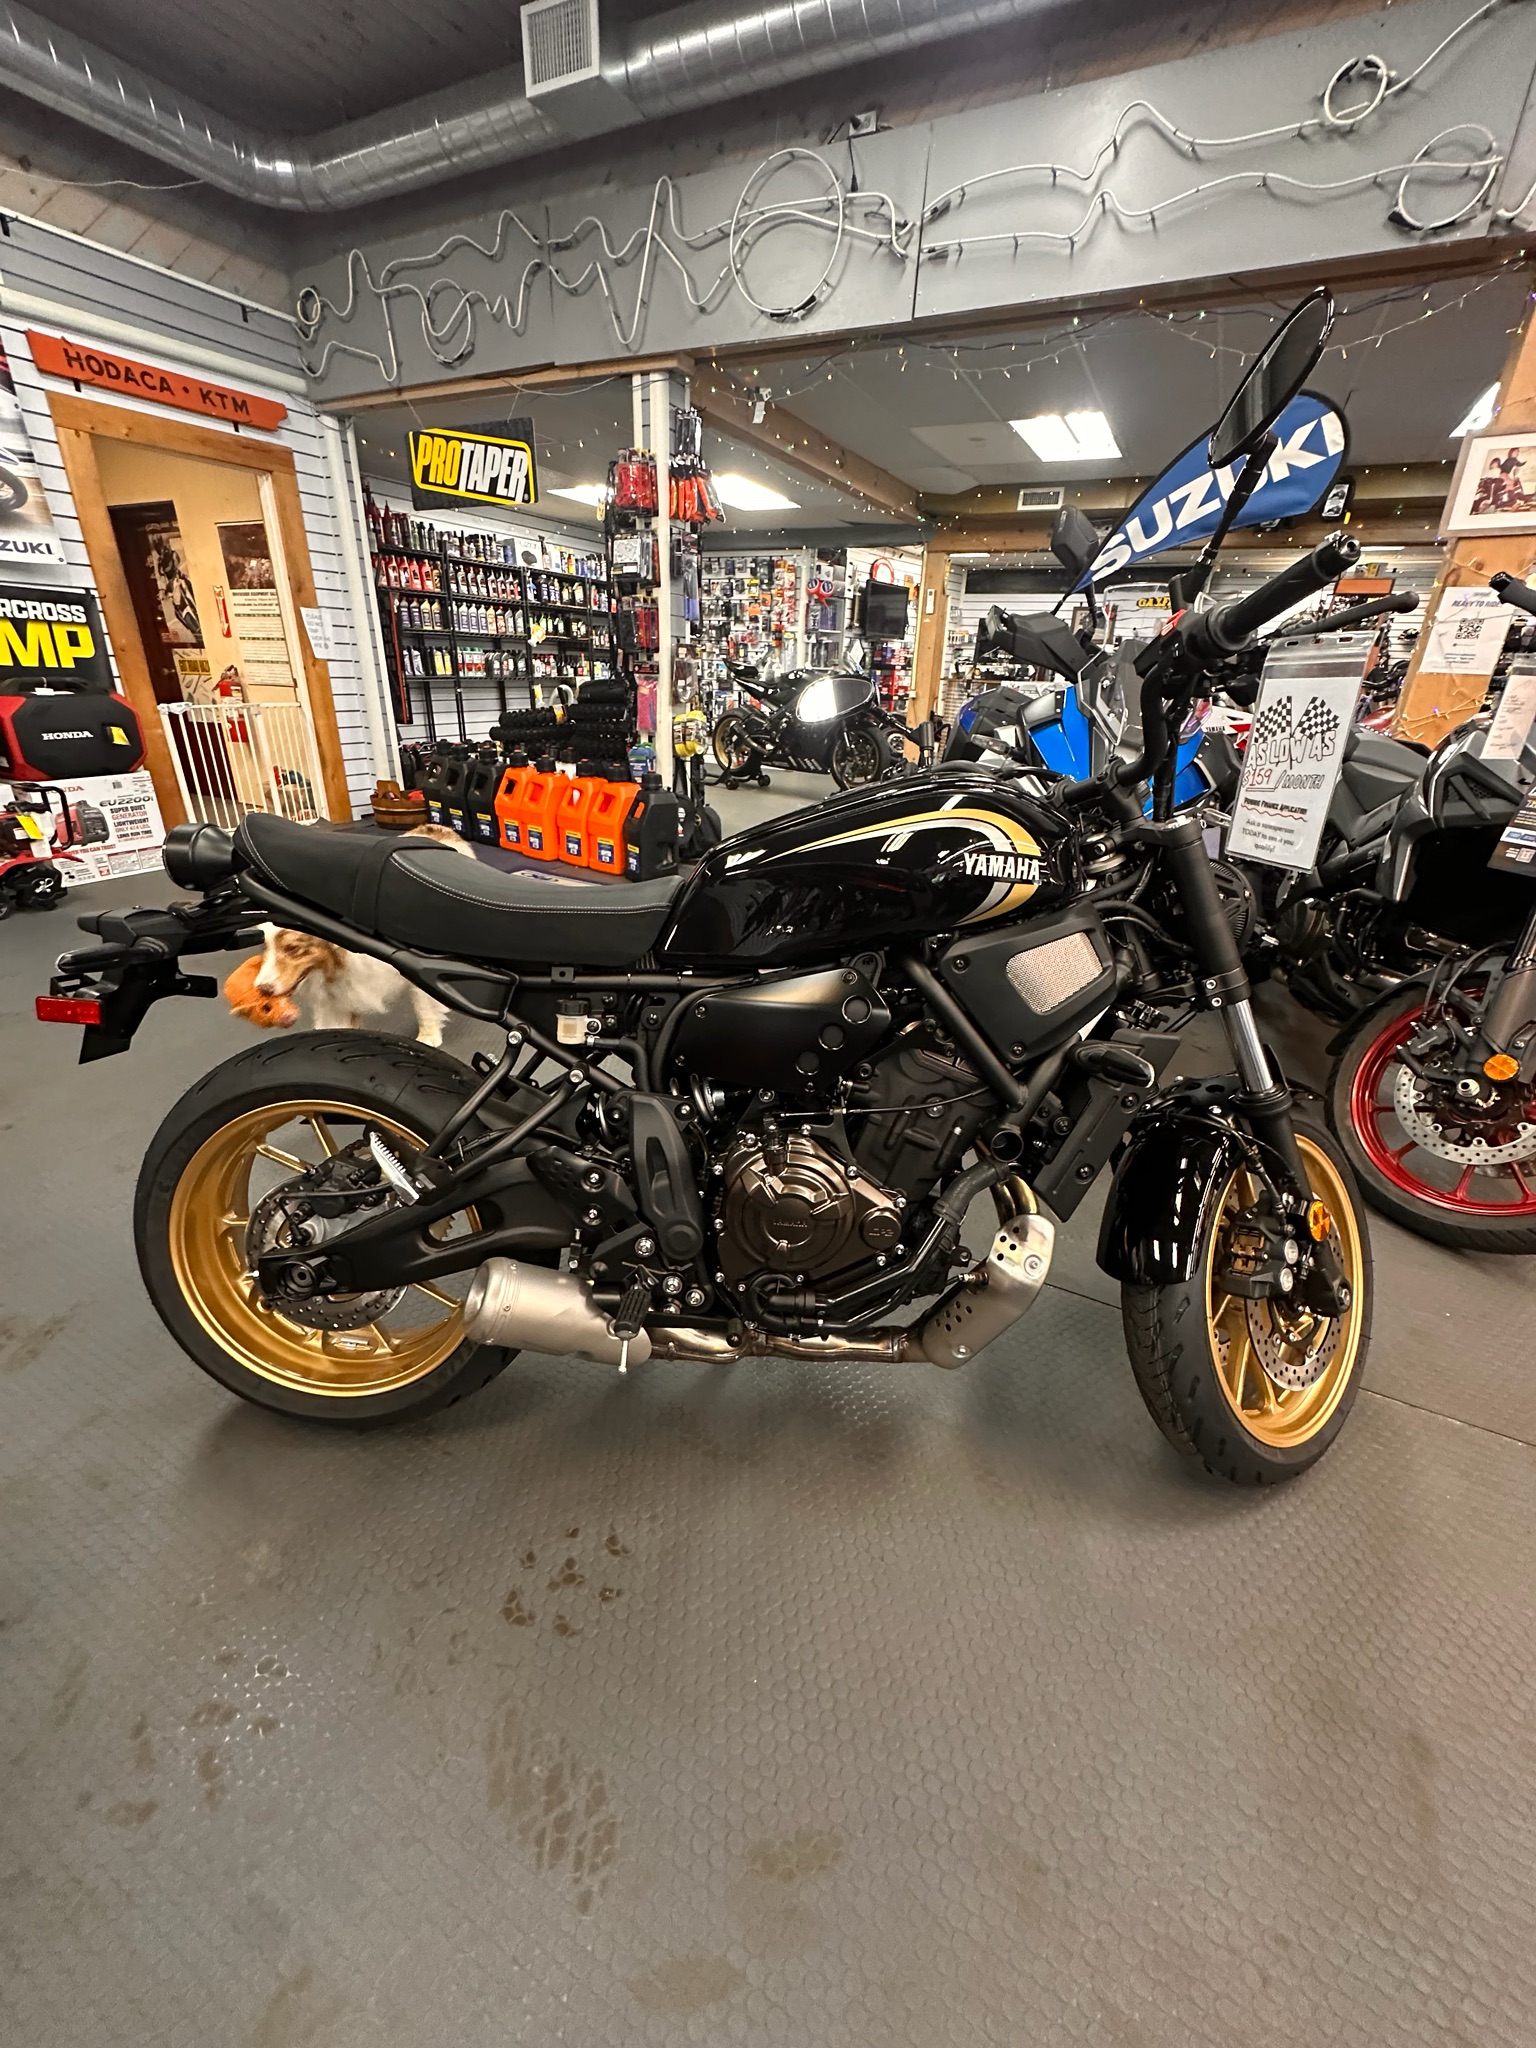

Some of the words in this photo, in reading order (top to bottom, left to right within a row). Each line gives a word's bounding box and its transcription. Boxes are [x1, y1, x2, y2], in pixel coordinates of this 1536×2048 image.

[63, 347, 175, 397] HODACA
[199, 387, 250, 416] KTM
[417, 434, 529, 504] PROTAPER
[41, 730, 94, 741] HONDA
[1269, 735, 1308, 763] LOW
[1309, 730, 1336, 761] AS
[110, 806, 130, 814] SUPER
[112, 812, 147, 820] GENERATOR
[963, 852, 1040, 881] YAMAHA
